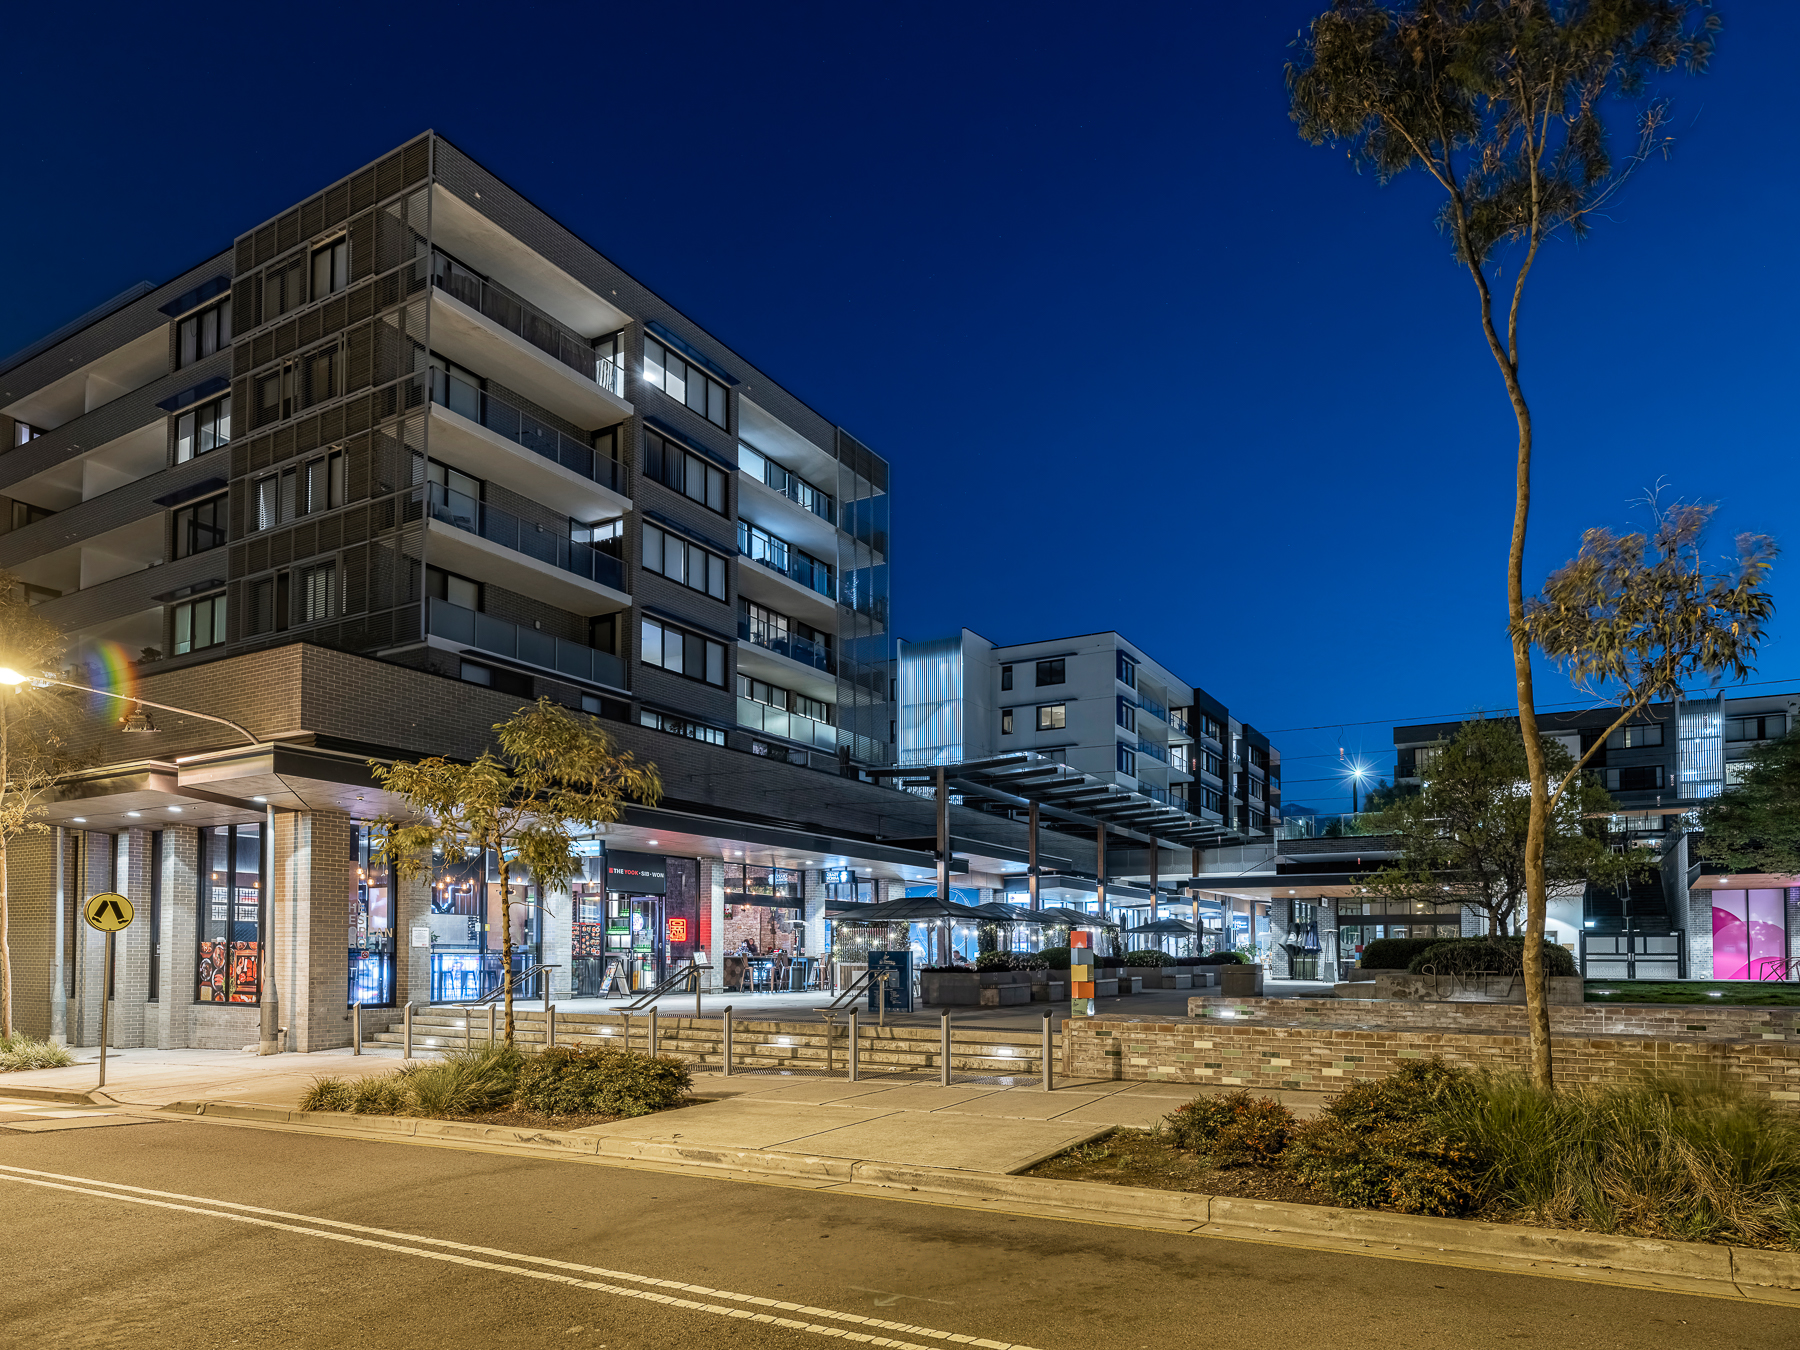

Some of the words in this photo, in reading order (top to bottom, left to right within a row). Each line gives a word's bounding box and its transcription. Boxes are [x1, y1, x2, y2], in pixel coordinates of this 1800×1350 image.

[613, 867, 624, 875] THE
[349, 902, 366, 914] HE
[349, 914, 374, 925] EST
[348, 926, 393, 938] OREAN
